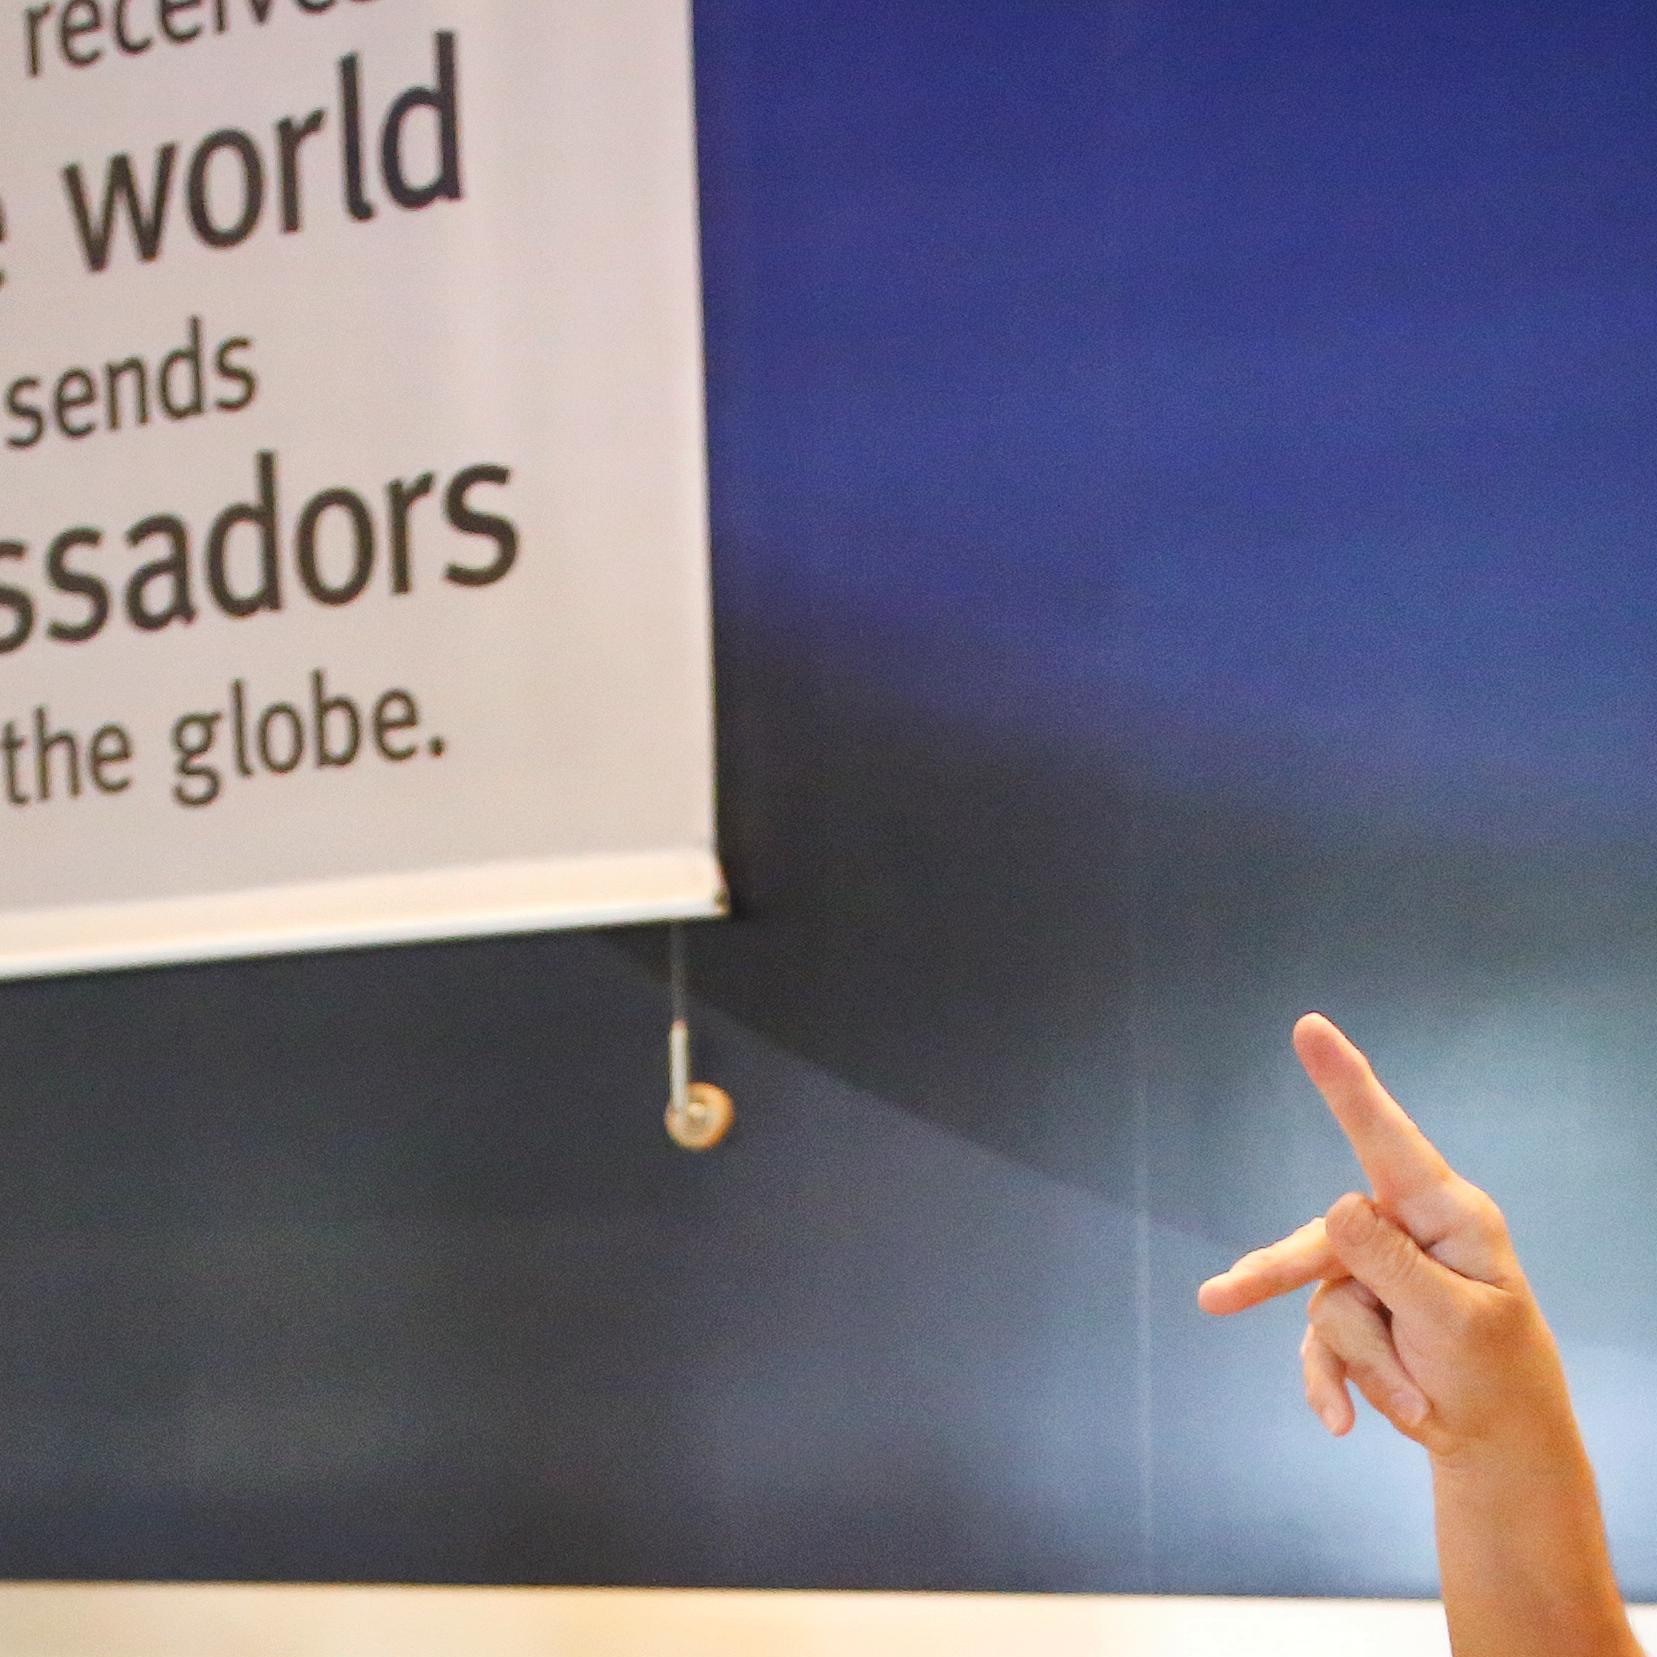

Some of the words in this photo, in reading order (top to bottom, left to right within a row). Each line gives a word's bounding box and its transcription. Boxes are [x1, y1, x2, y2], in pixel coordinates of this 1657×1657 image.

[24, 0, 378, 77] rece
[62, 30, 462, 272] world
[5, 315, 258, 450] sends
[0, 706, 134, 805] the
[172, 668, 447, 806] globe.
